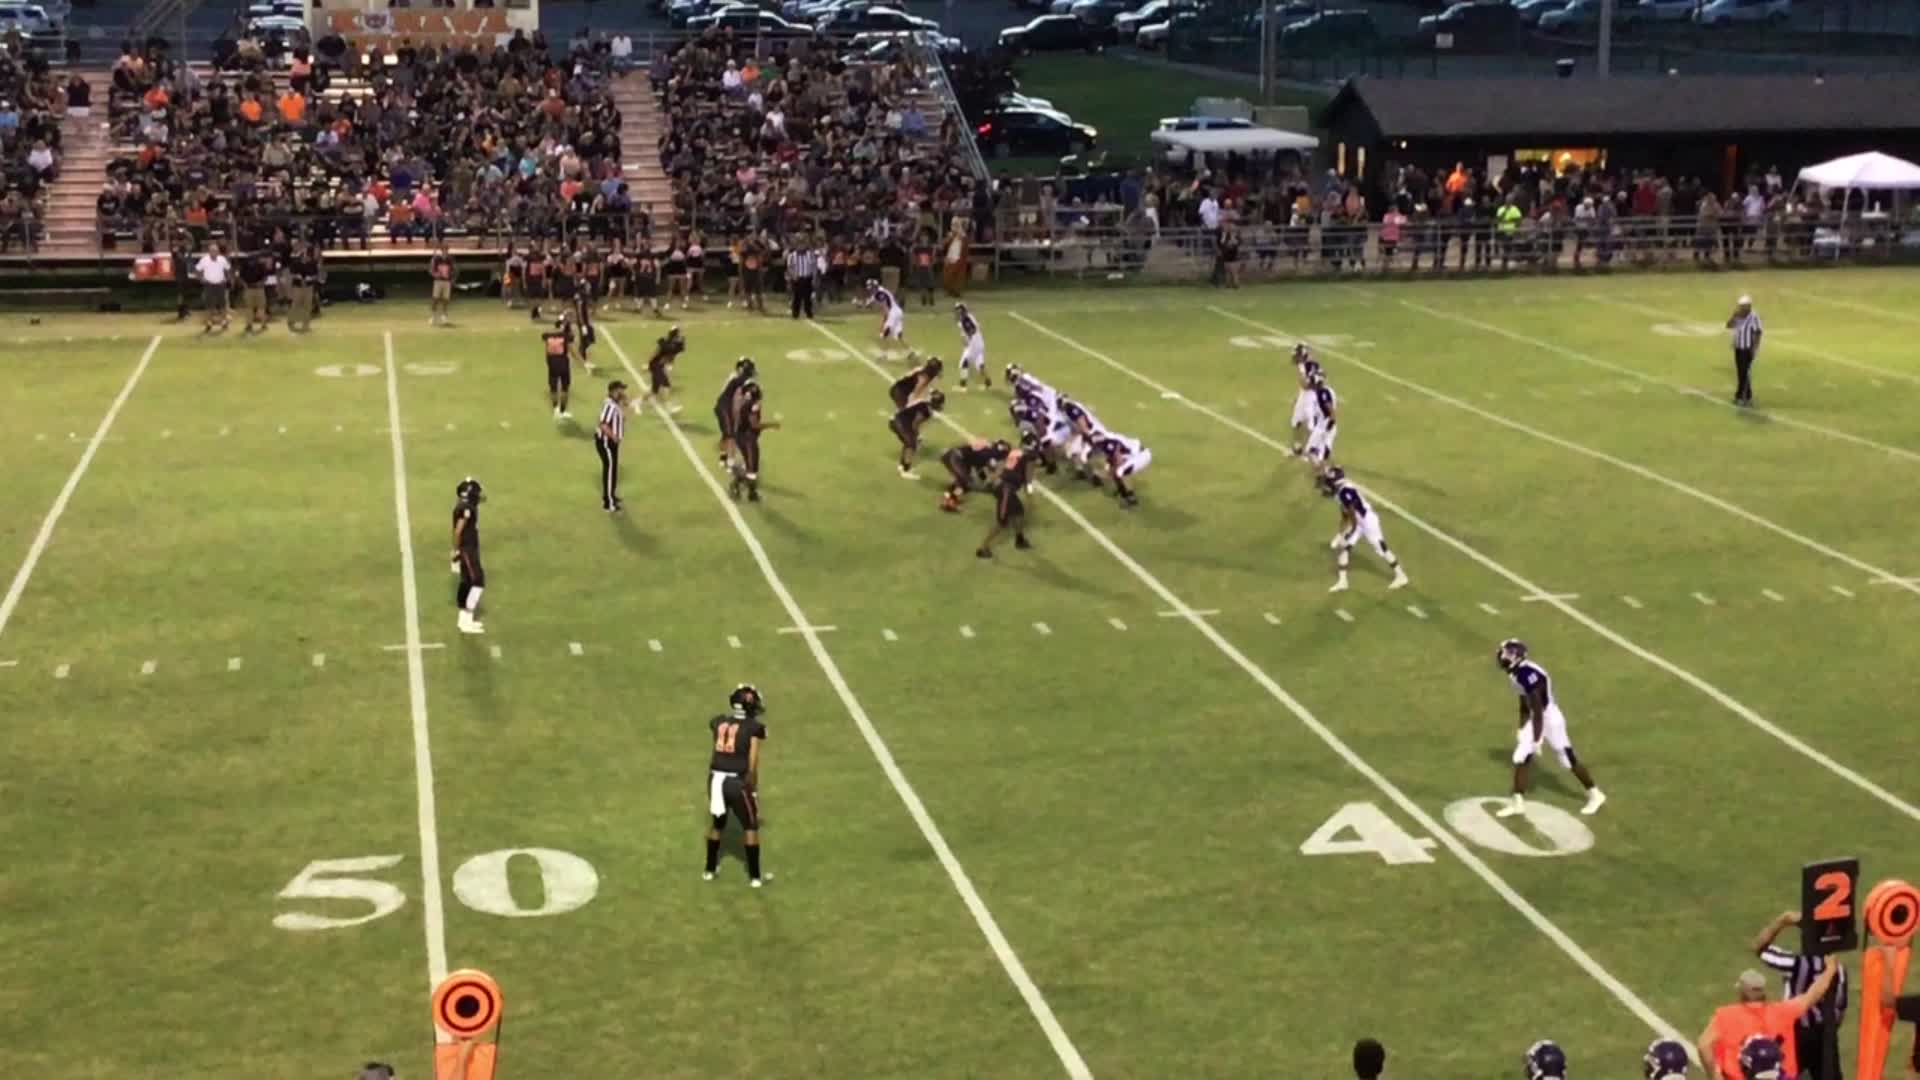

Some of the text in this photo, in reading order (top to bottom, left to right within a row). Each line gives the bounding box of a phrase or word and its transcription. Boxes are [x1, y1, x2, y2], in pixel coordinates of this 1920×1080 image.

[715, 721, 740, 753] 11
[1300, 796, 1595, 864] 40
[272, 847, 599, 930] 50
[1813, 871, 1851, 920] 2
